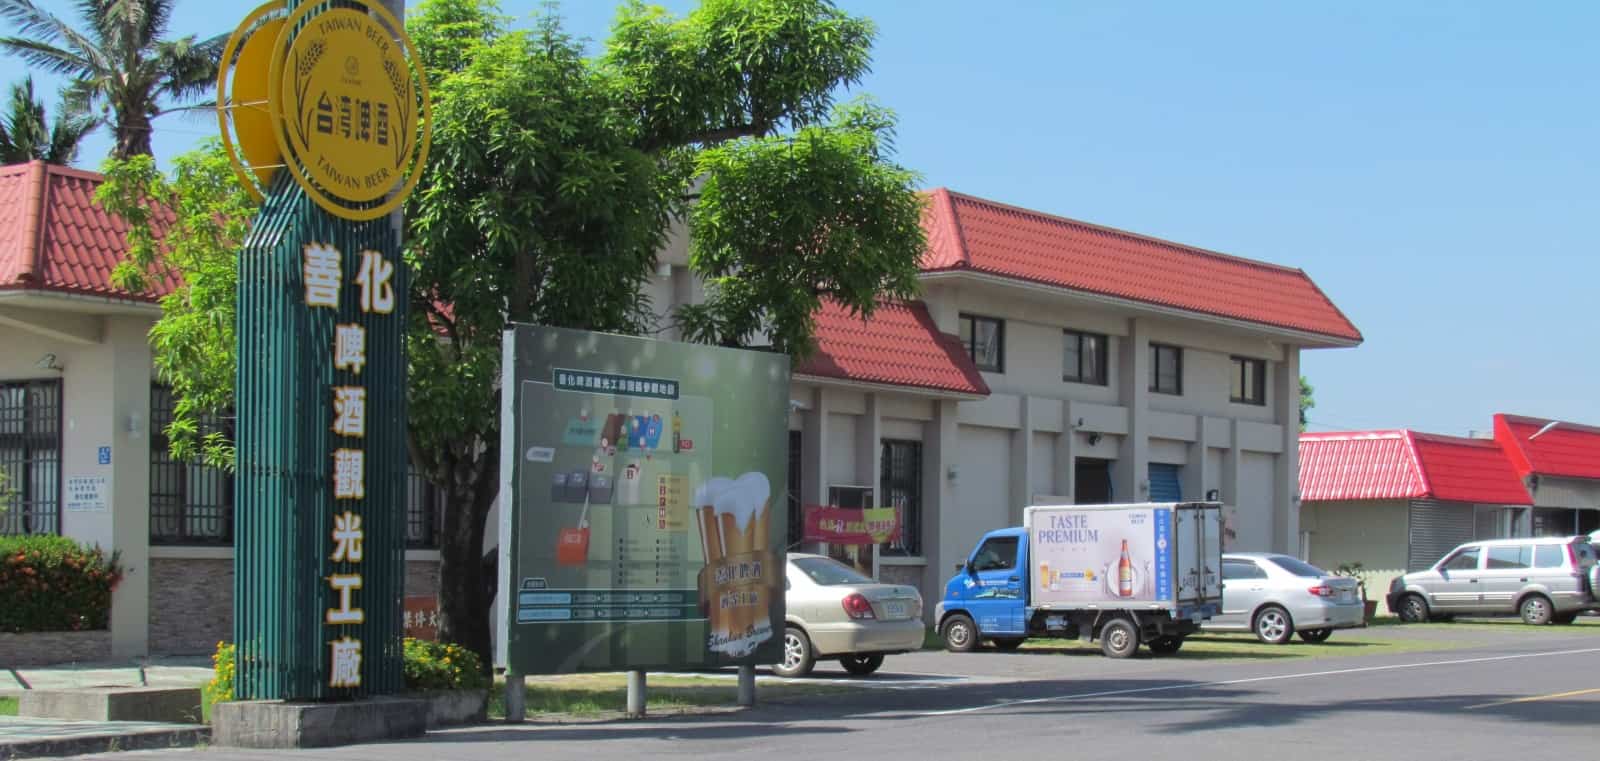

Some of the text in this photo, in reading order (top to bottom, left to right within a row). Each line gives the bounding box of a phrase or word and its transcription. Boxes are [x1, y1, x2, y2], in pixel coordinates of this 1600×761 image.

[319, 16, 390, 52] TAIWAN BEER
[315, 154, 391, 191] TAIWAN BEER
[304, 240, 394, 314] 善化
[326, 322, 366, 688] 啤酒觀光工廠
[1049, 514, 1088, 529] TASTE
[1038, 529, 1100, 545] PREMIUM
